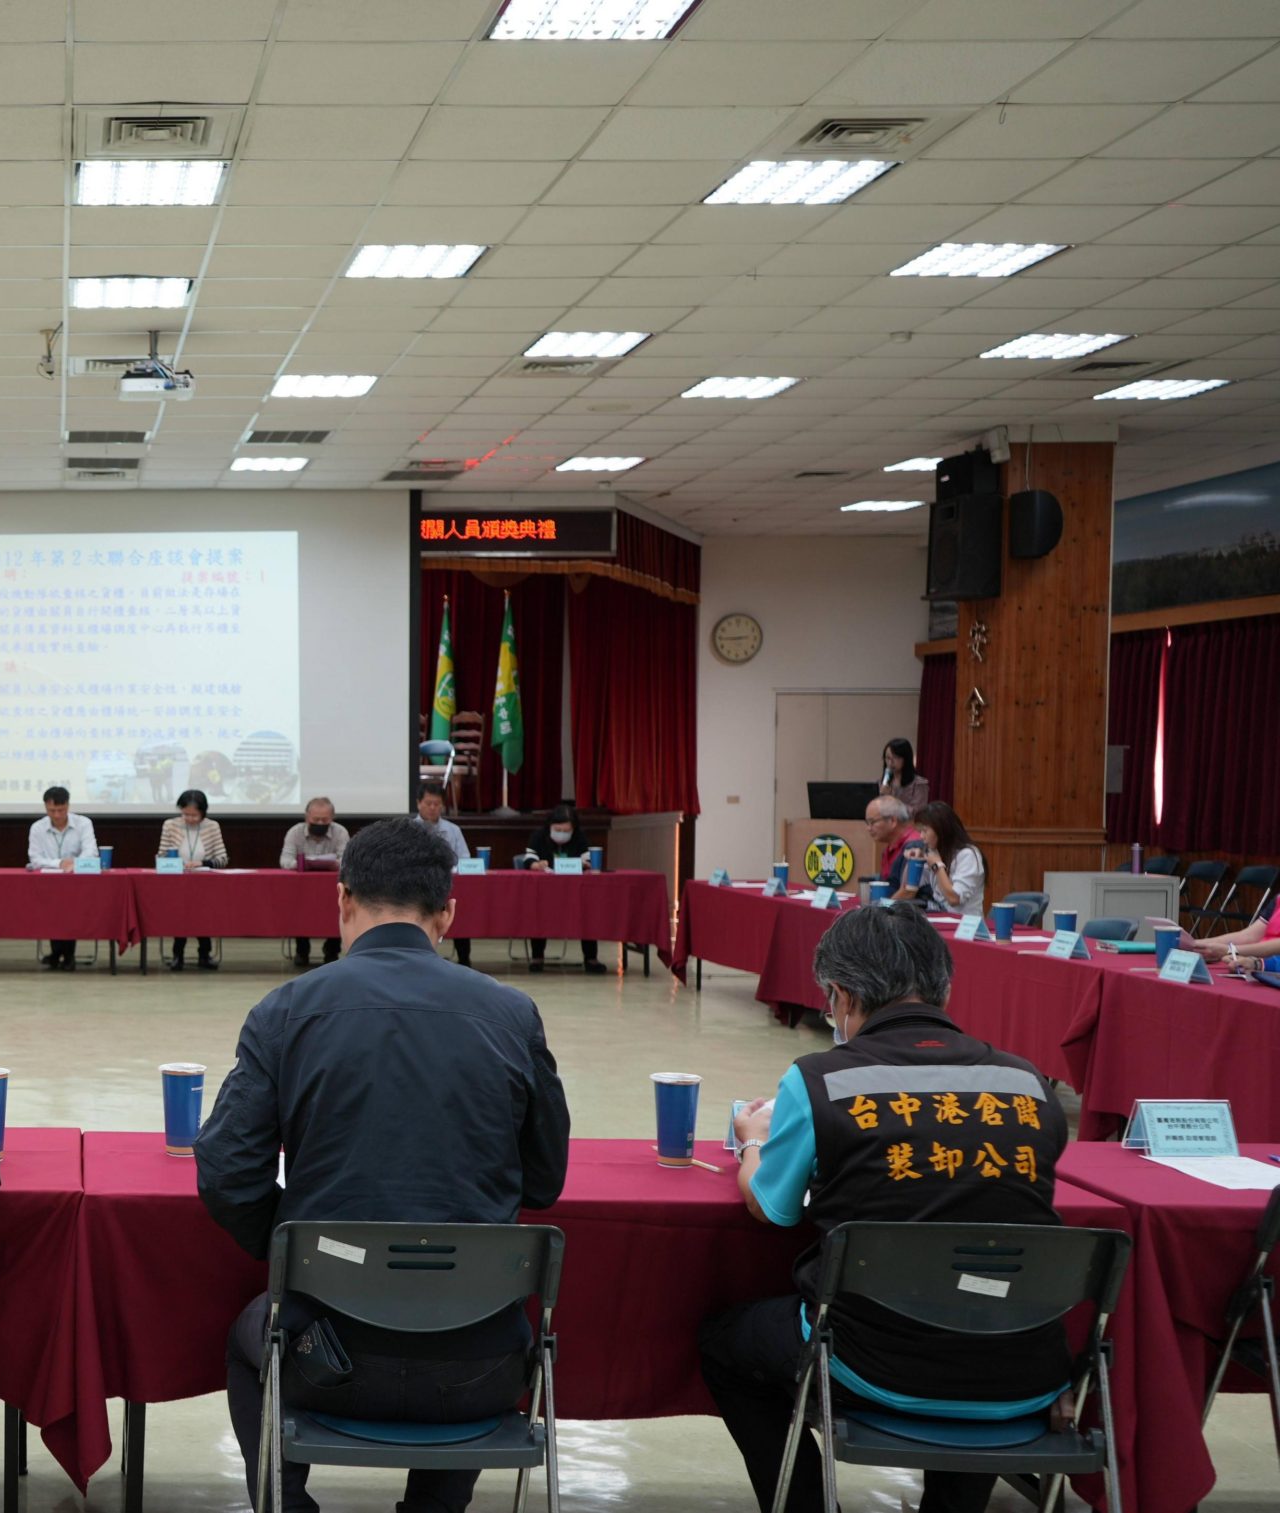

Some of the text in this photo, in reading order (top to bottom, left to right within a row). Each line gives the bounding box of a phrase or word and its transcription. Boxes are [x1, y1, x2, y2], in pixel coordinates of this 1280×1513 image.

[847, 1092, 1041, 1130] 台中港倉儲
[886, 1141, 1039, 1183] 裝卸公司
